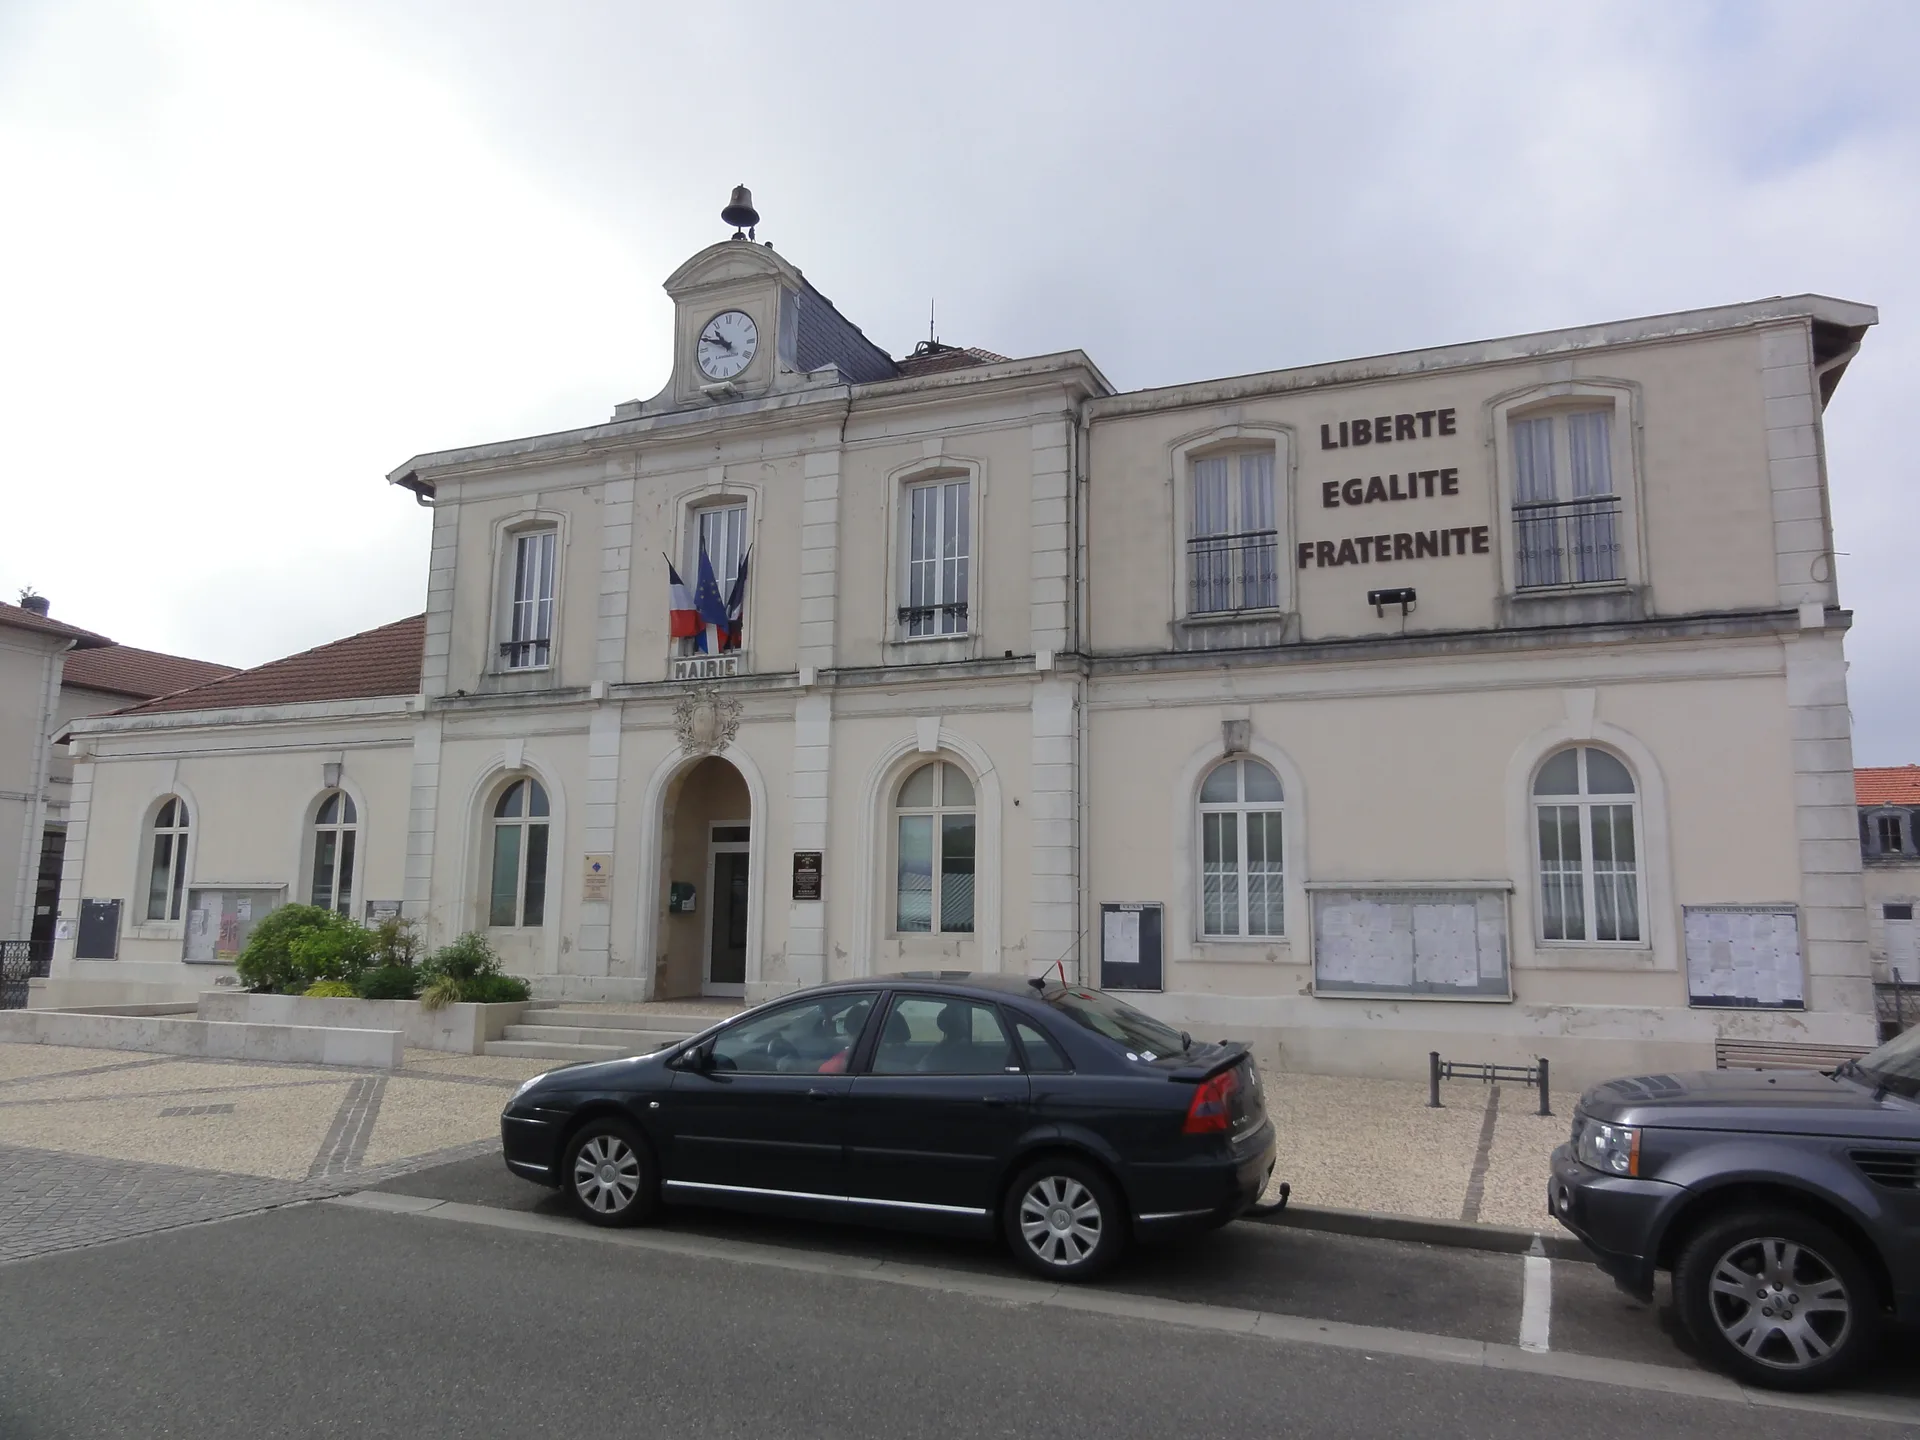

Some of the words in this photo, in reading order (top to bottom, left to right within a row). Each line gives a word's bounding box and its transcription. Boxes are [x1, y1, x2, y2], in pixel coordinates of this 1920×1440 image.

[1321, 408, 1456, 450] LIBERTE
[1322, 468, 1459, 508] EGALITE
[1299, 526, 1489, 568] FRATERNITE
[675, 659, 736, 679] MAIRIE
